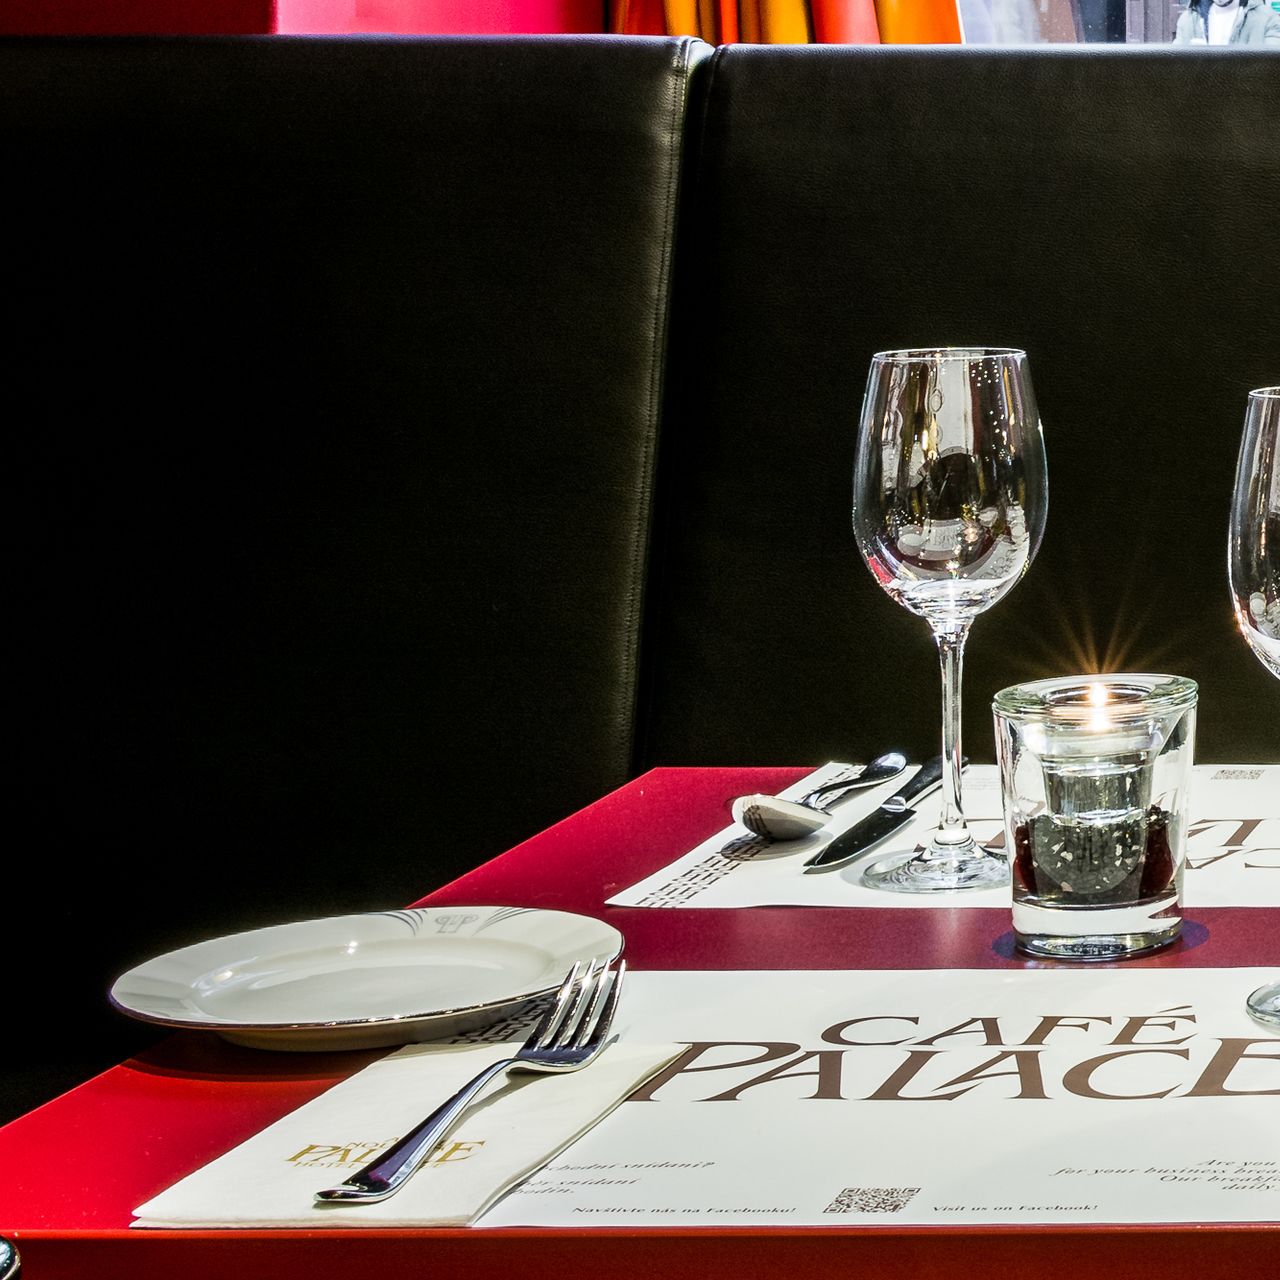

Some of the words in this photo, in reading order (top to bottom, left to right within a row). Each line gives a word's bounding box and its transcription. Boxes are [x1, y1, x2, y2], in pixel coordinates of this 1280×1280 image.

[821, 1005, 1197, 1046] CAFÉ
[1242, 1160, 1278, 1168] you
[1048, 1167, 1084, 1176] for
[1221, 1182, 1275, 1191] daily
